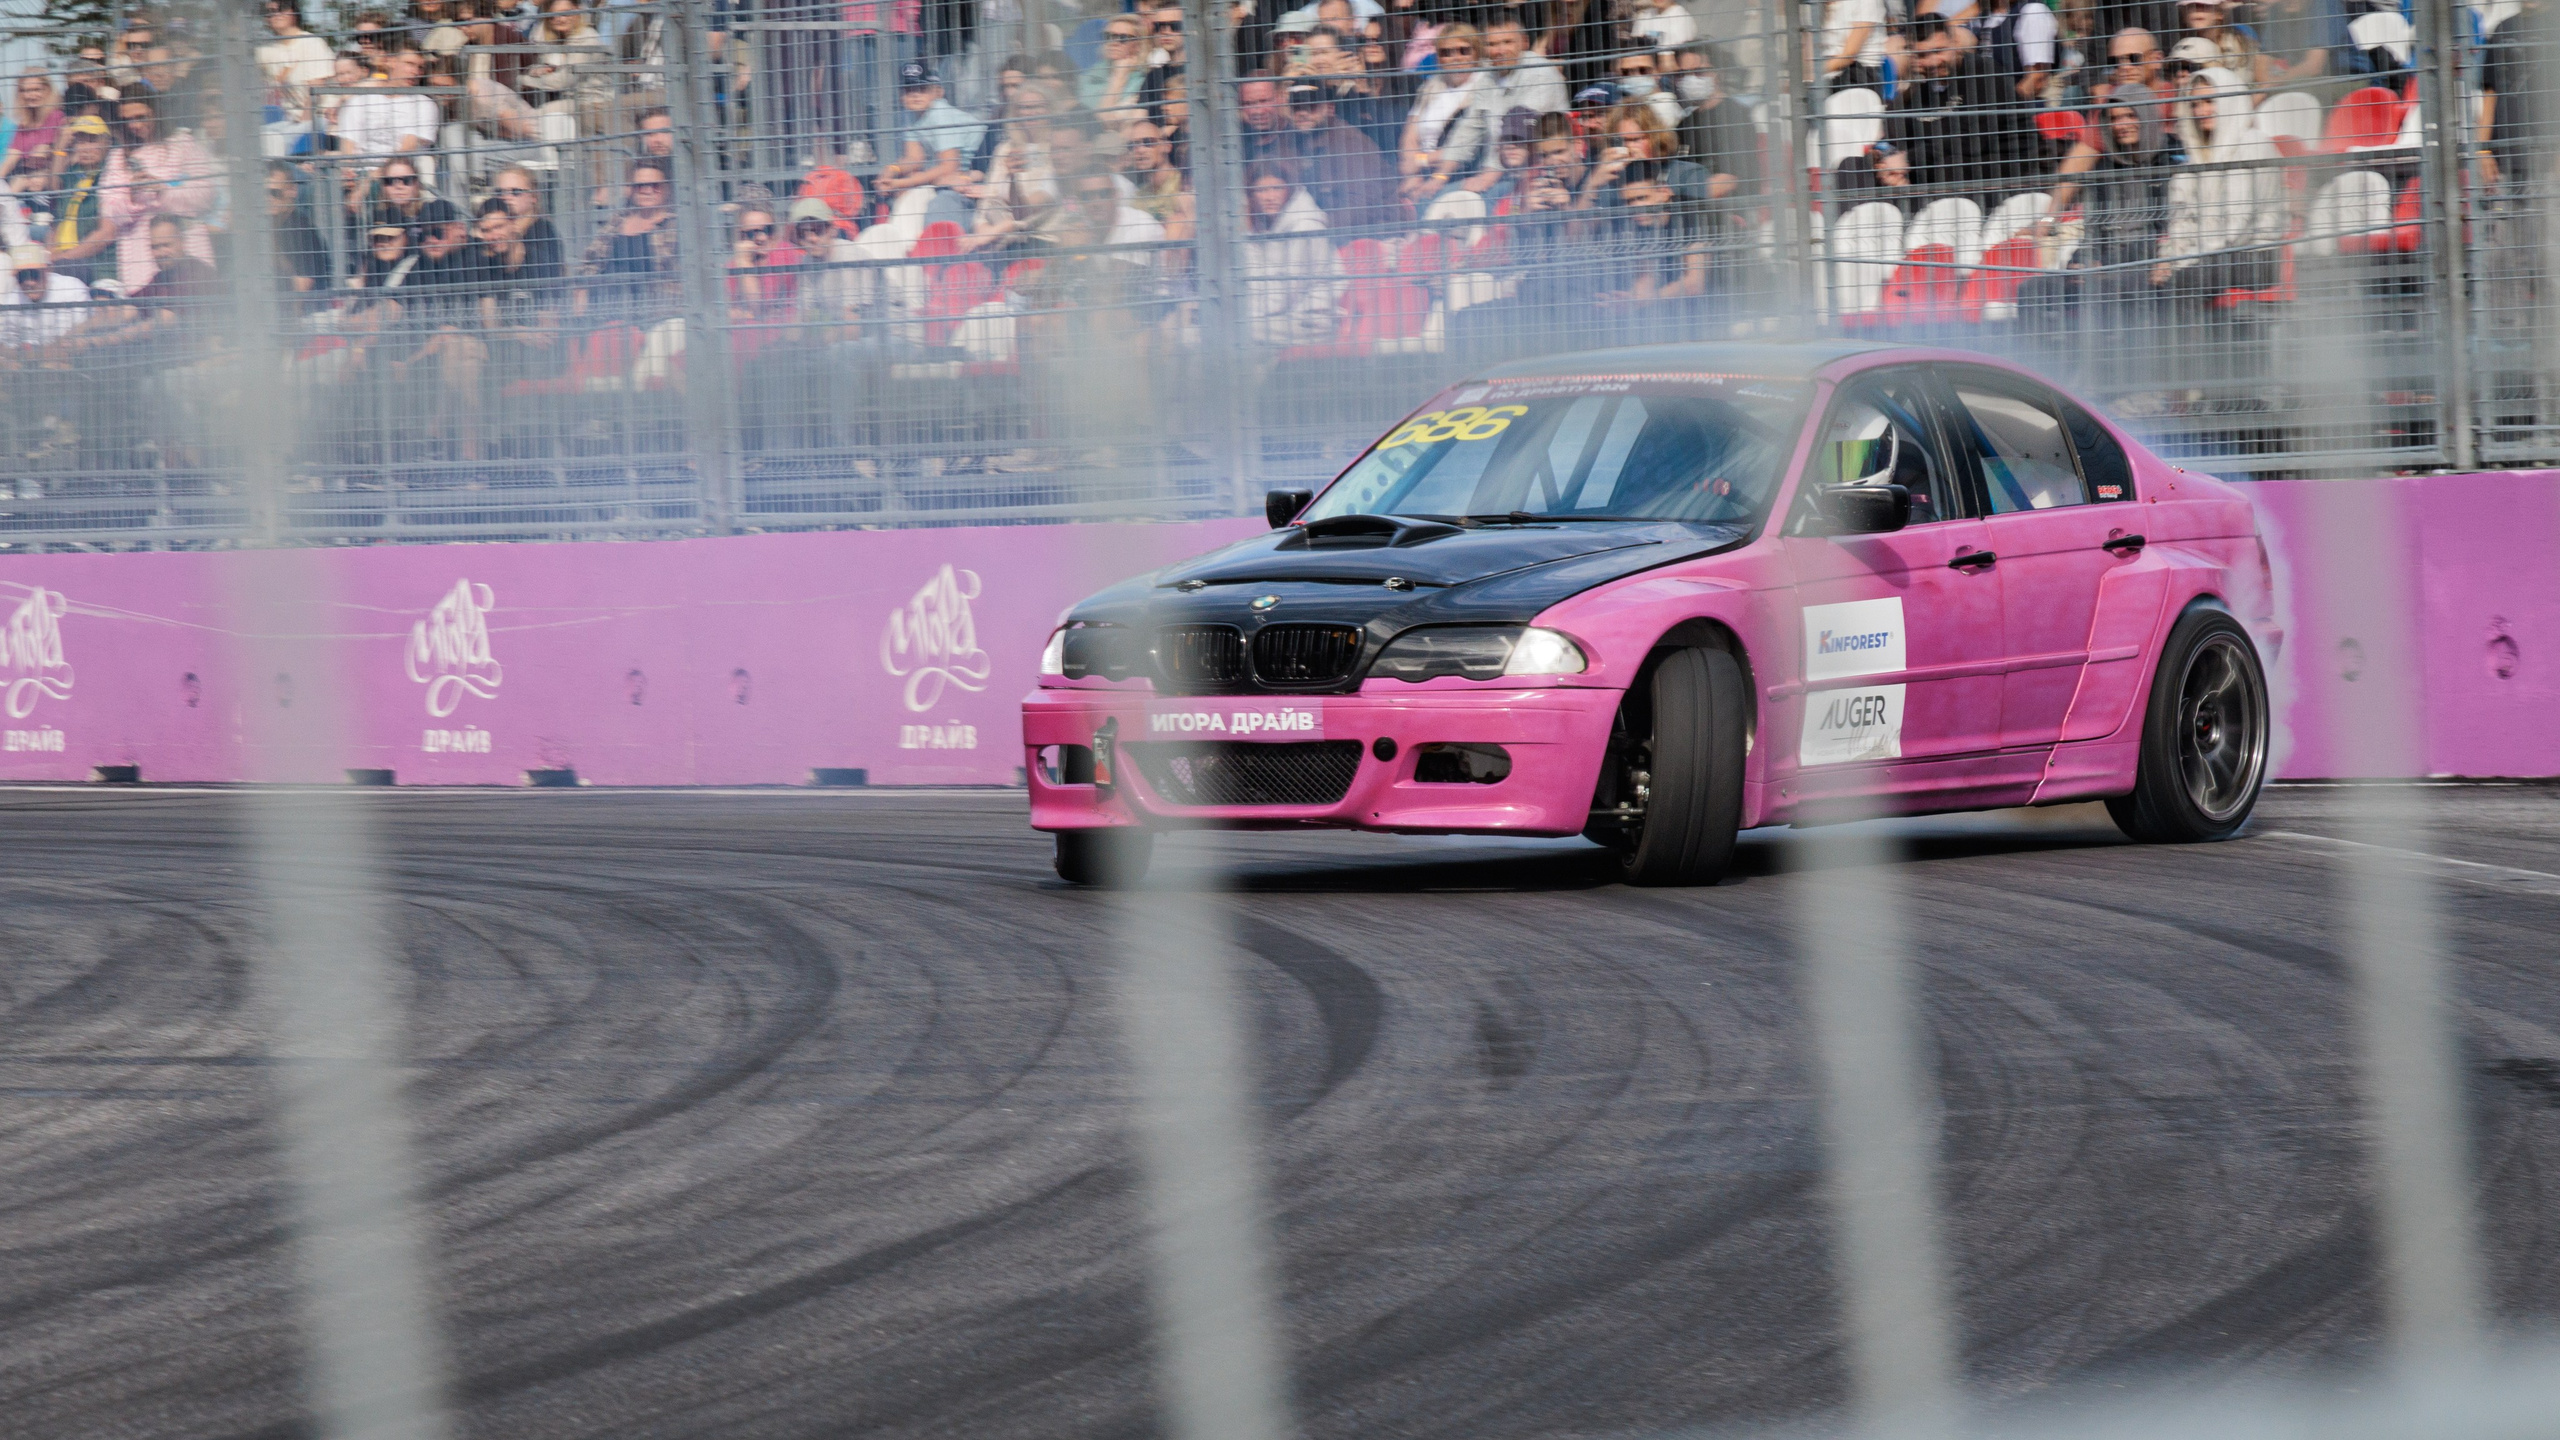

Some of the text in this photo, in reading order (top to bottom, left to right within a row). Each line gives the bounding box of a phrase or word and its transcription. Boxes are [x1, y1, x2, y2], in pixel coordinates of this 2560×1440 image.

[1376, 405, 1529, 450] 686
[1818, 630, 1889, 654] KINFOREST
[1152, 707, 1314, 734] ИГОРА ДРАЙВ
[1819, 695, 1886, 730] AUGER
[1, 724, 66, 753] ДРАЙВ
[421, 725, 493, 754] ДРАЙВ
[898, 719, 979, 750] ДРАЙВ
